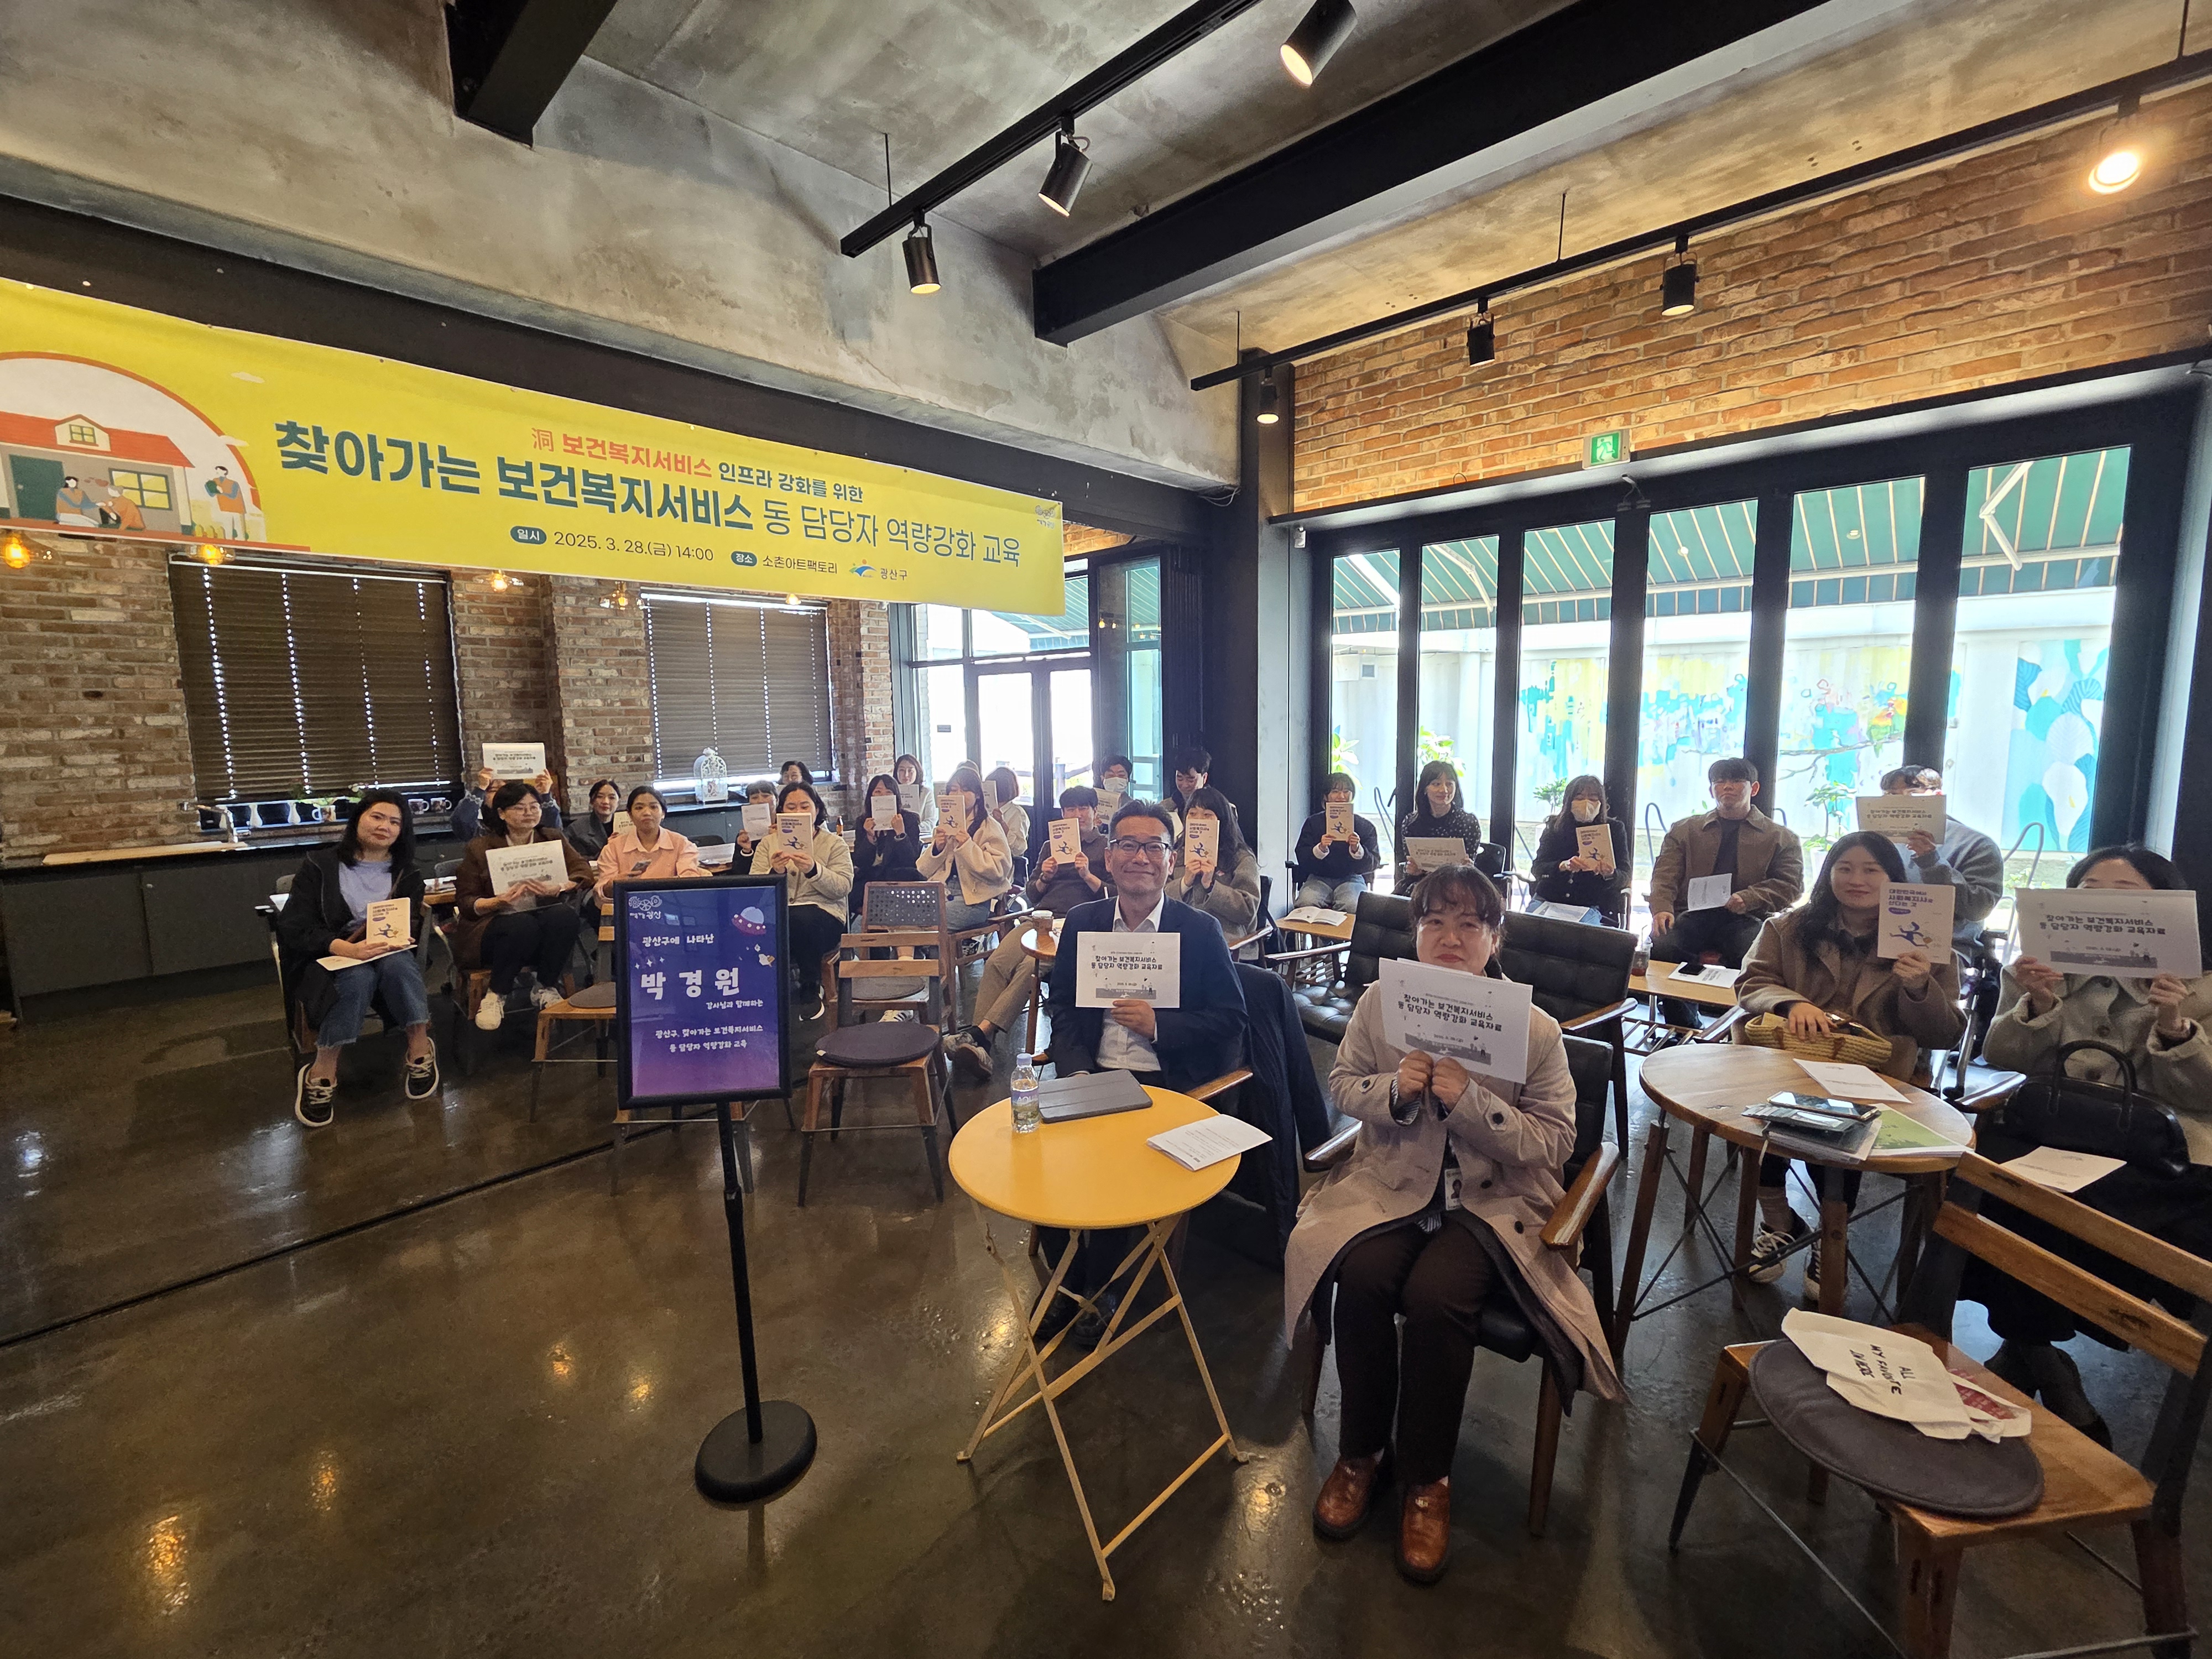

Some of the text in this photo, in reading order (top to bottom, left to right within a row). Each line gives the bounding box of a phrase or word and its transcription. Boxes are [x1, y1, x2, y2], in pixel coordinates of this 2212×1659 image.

[531, 427, 863, 503] 洞 보건복지서비스 인프라 강화를 위한
[274, 421, 1020, 567] 찾아가는 보건복지서비스 동 담당자 역량강화 교육
[517, 529, 838, 575] 일시 2025. 3. 28.(금) 14:00 장소 소촌아트팩토리
[880, 568, 907, 581] 광산구
[642, 933, 714, 947] 광산구에 나타난
[641, 968, 739, 1000] 박 경 원
[706, 999, 763, 1010] 강사님과 함께하는
[1404, 994, 1435, 1009] 찾아가는
[1438, 1002, 1493, 1021] 보건복지서비스
[1398, 1001, 1502, 1032] 동 담당자 역량강화 교육자료
[682, 1027, 712, 1037] 찾아가는
[713, 1025, 763, 1035] 보건복지서비스
[670, 1039, 747, 1053] 동 담당자 역량강화 교육
[1898, 1366, 1916, 1379] ALL
